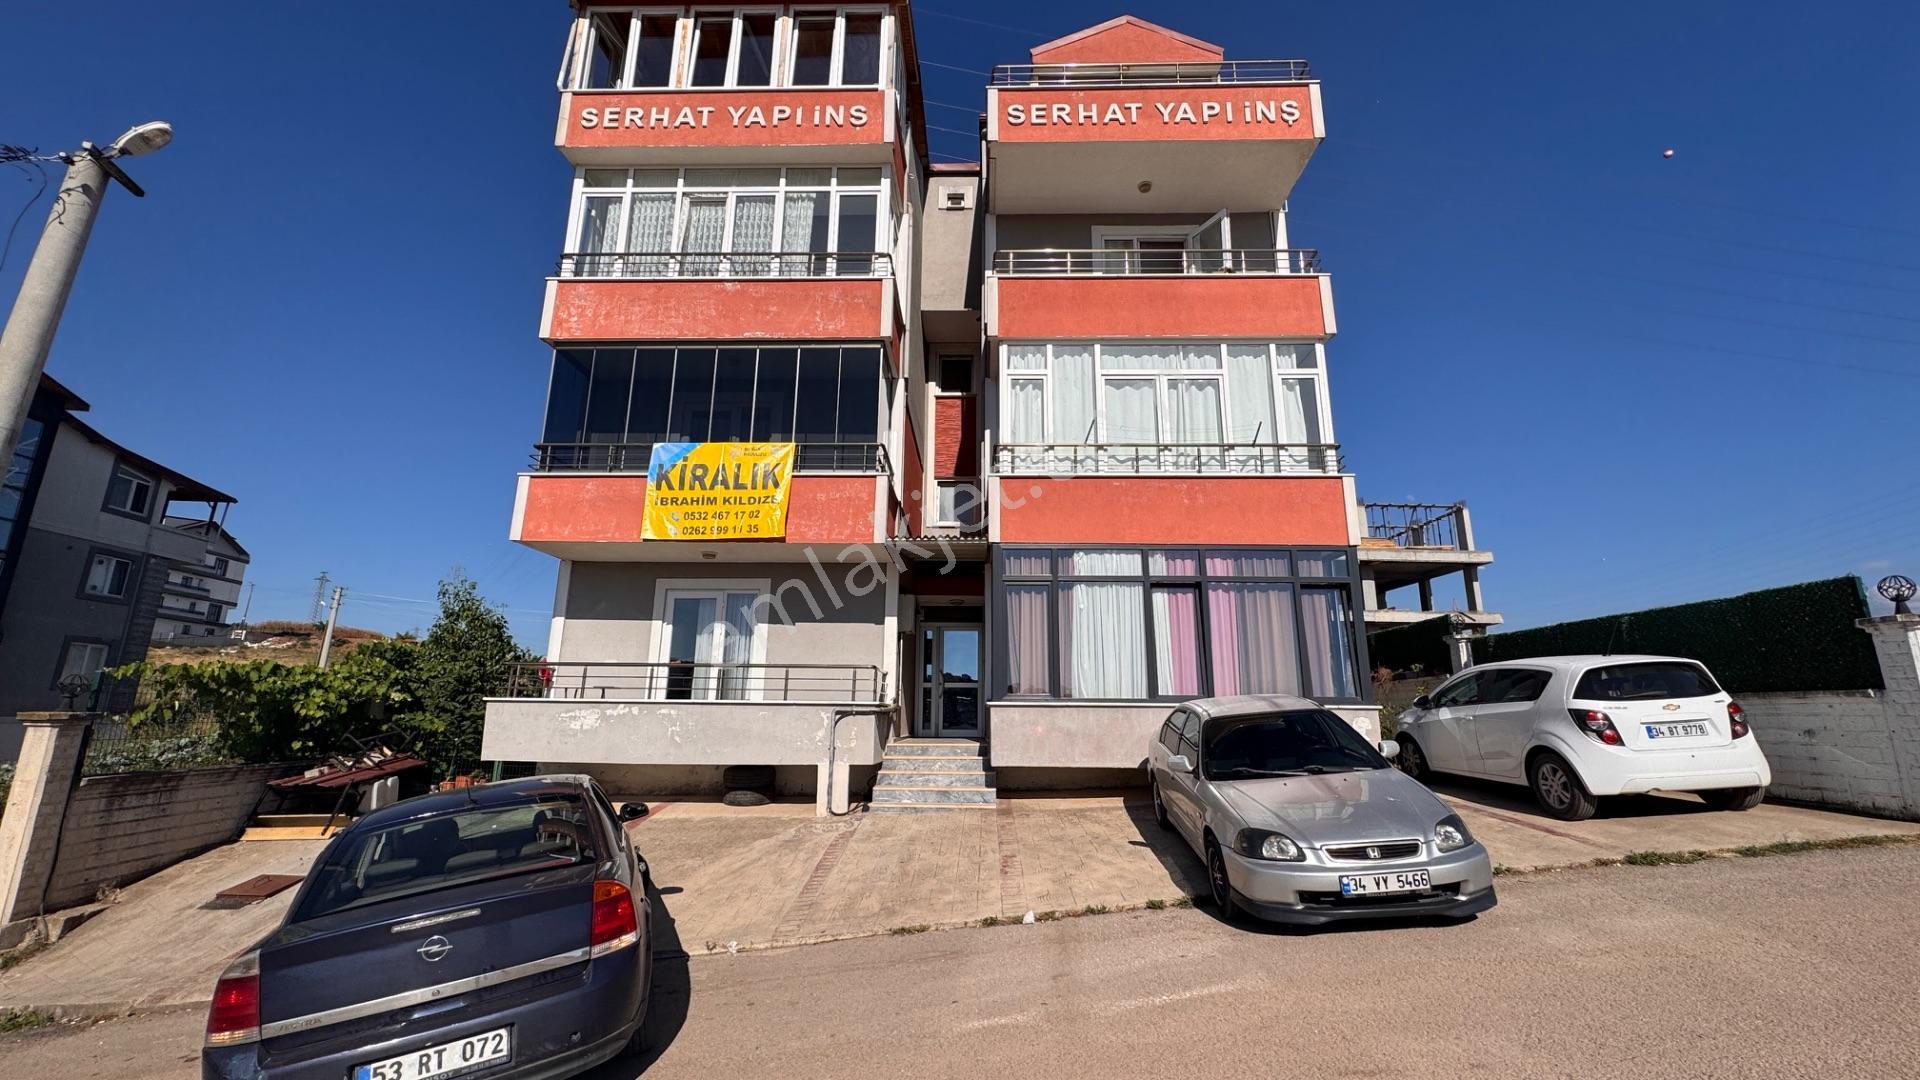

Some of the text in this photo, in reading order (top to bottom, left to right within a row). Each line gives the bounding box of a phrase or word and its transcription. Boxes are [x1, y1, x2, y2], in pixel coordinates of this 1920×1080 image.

[580, 106, 715, 129] SERHAT
[727, 105, 803, 128] YAPI
[1007, 103, 1143, 126] SERHAT
[1155, 101, 1233, 124] YAPI
[655, 455, 782, 491] KİRALIK
[683, 509, 760, 521] 0532 467 17 02
[682, 525, 707, 536] 0262
[746, 524, 759, 533] 35
[1653, 726, 1665, 737] 34
[1668, 726, 1680, 736] BT
[1351, 872, 1428, 892] 34 VY 5466
[372, 1061, 403, 1080] 53
[418, 1047, 447, 1076] RT
[462, 1033, 504, 1062] 072
